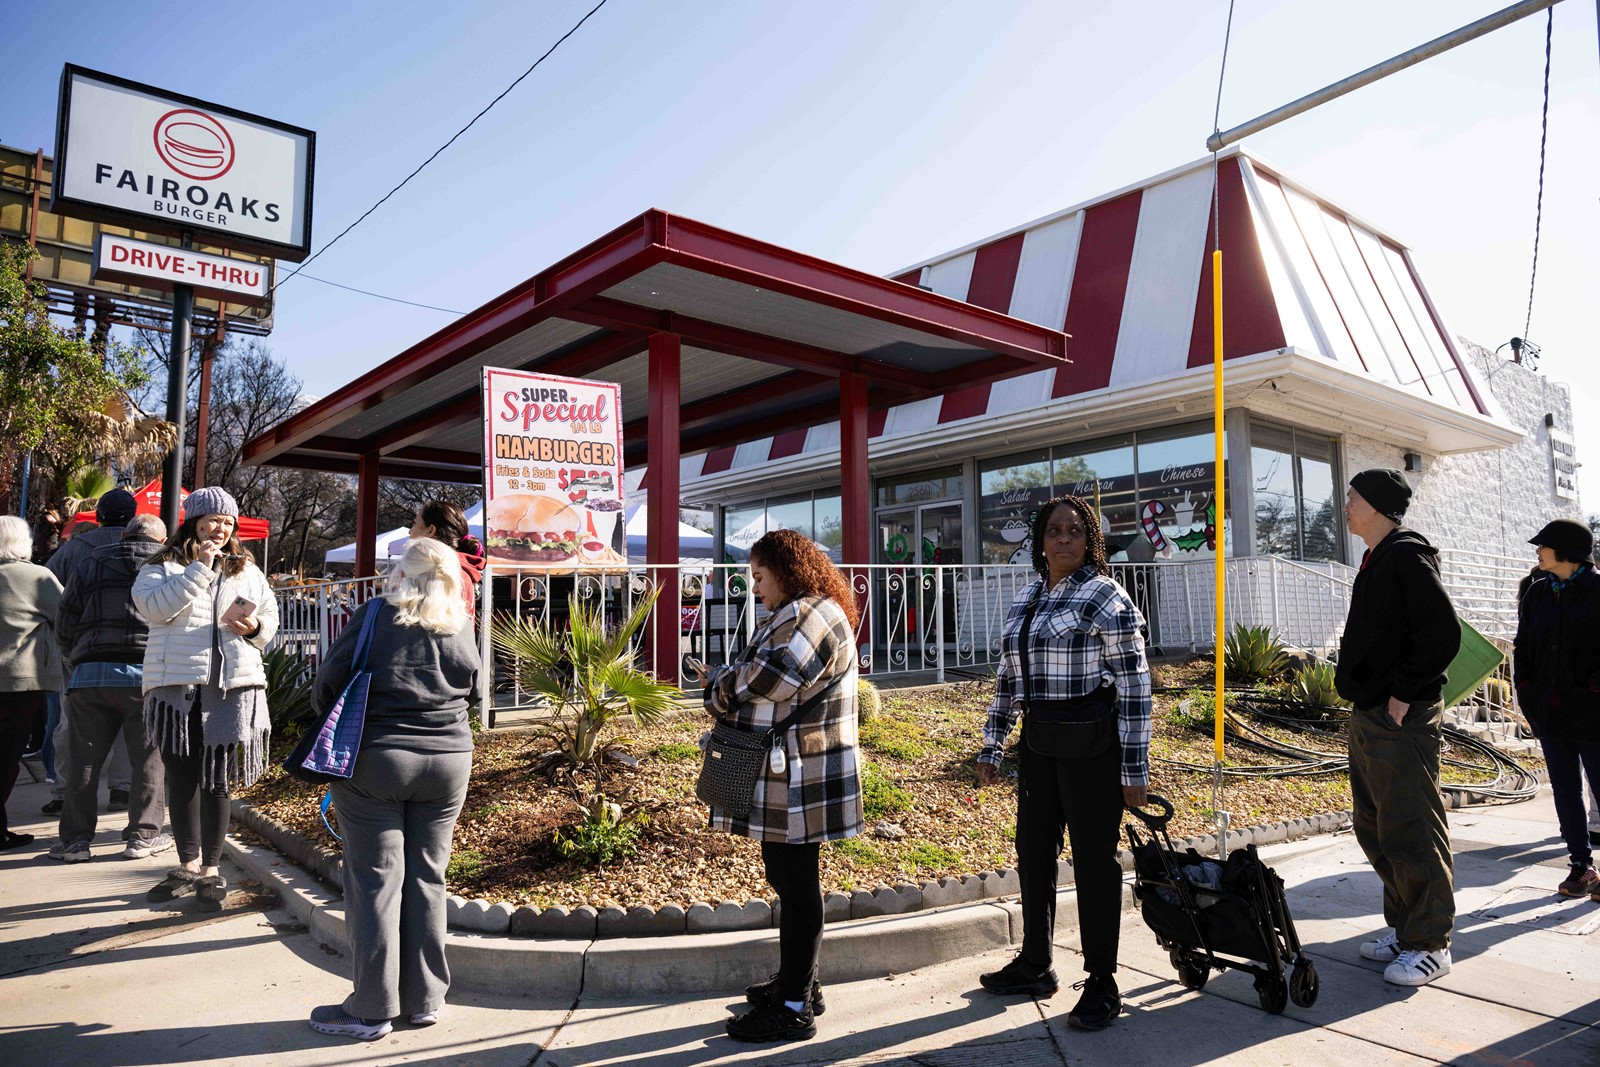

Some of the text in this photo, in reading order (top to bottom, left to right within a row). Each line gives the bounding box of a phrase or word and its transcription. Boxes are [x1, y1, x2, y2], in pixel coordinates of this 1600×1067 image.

[95, 163, 280, 223] FAIROAKS
[153, 199, 228, 226] BURGER
[110, 244, 260, 287] DRIVE-THRU
[521, 388, 568, 402] SUPER
[500, 391, 609, 432] Special
[570, 422, 601, 433] 1/4 LB
[496, 434, 615, 465] HAMBURGER
[496, 465, 555, 478] Fries & Soda
[1160, 464, 1206, 484] Chinese
[508, 479, 519, 489] 12
[527, 481, 545, 490] 3pm
[1072, 476, 1114, 495] Mexcan
[1000, 487, 1031, 505] Salads
